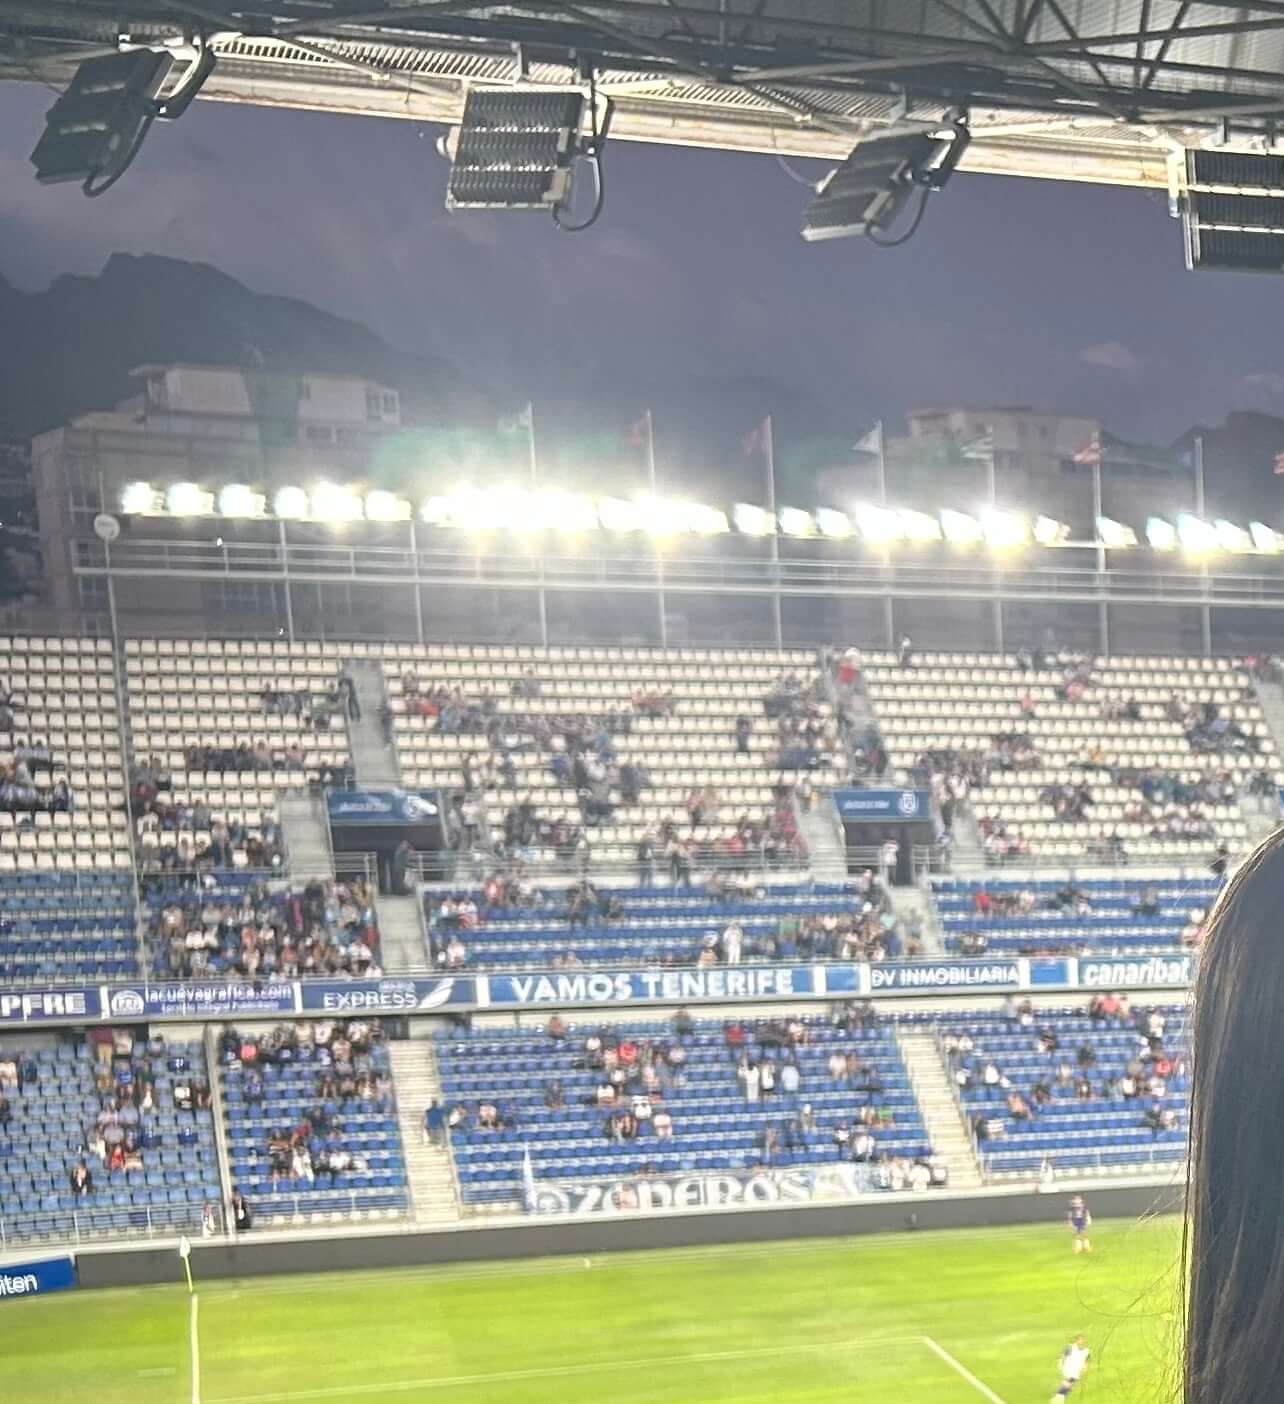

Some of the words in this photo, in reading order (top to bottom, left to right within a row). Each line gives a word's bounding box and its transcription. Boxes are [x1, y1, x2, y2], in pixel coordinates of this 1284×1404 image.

[511, 972, 633, 1001] VAMOS
[640, 967, 795, 998] TENERIFE
[900, 962, 1019, 987] INMOBILIARIA
[323, 991, 417, 1010] EXPRESS
